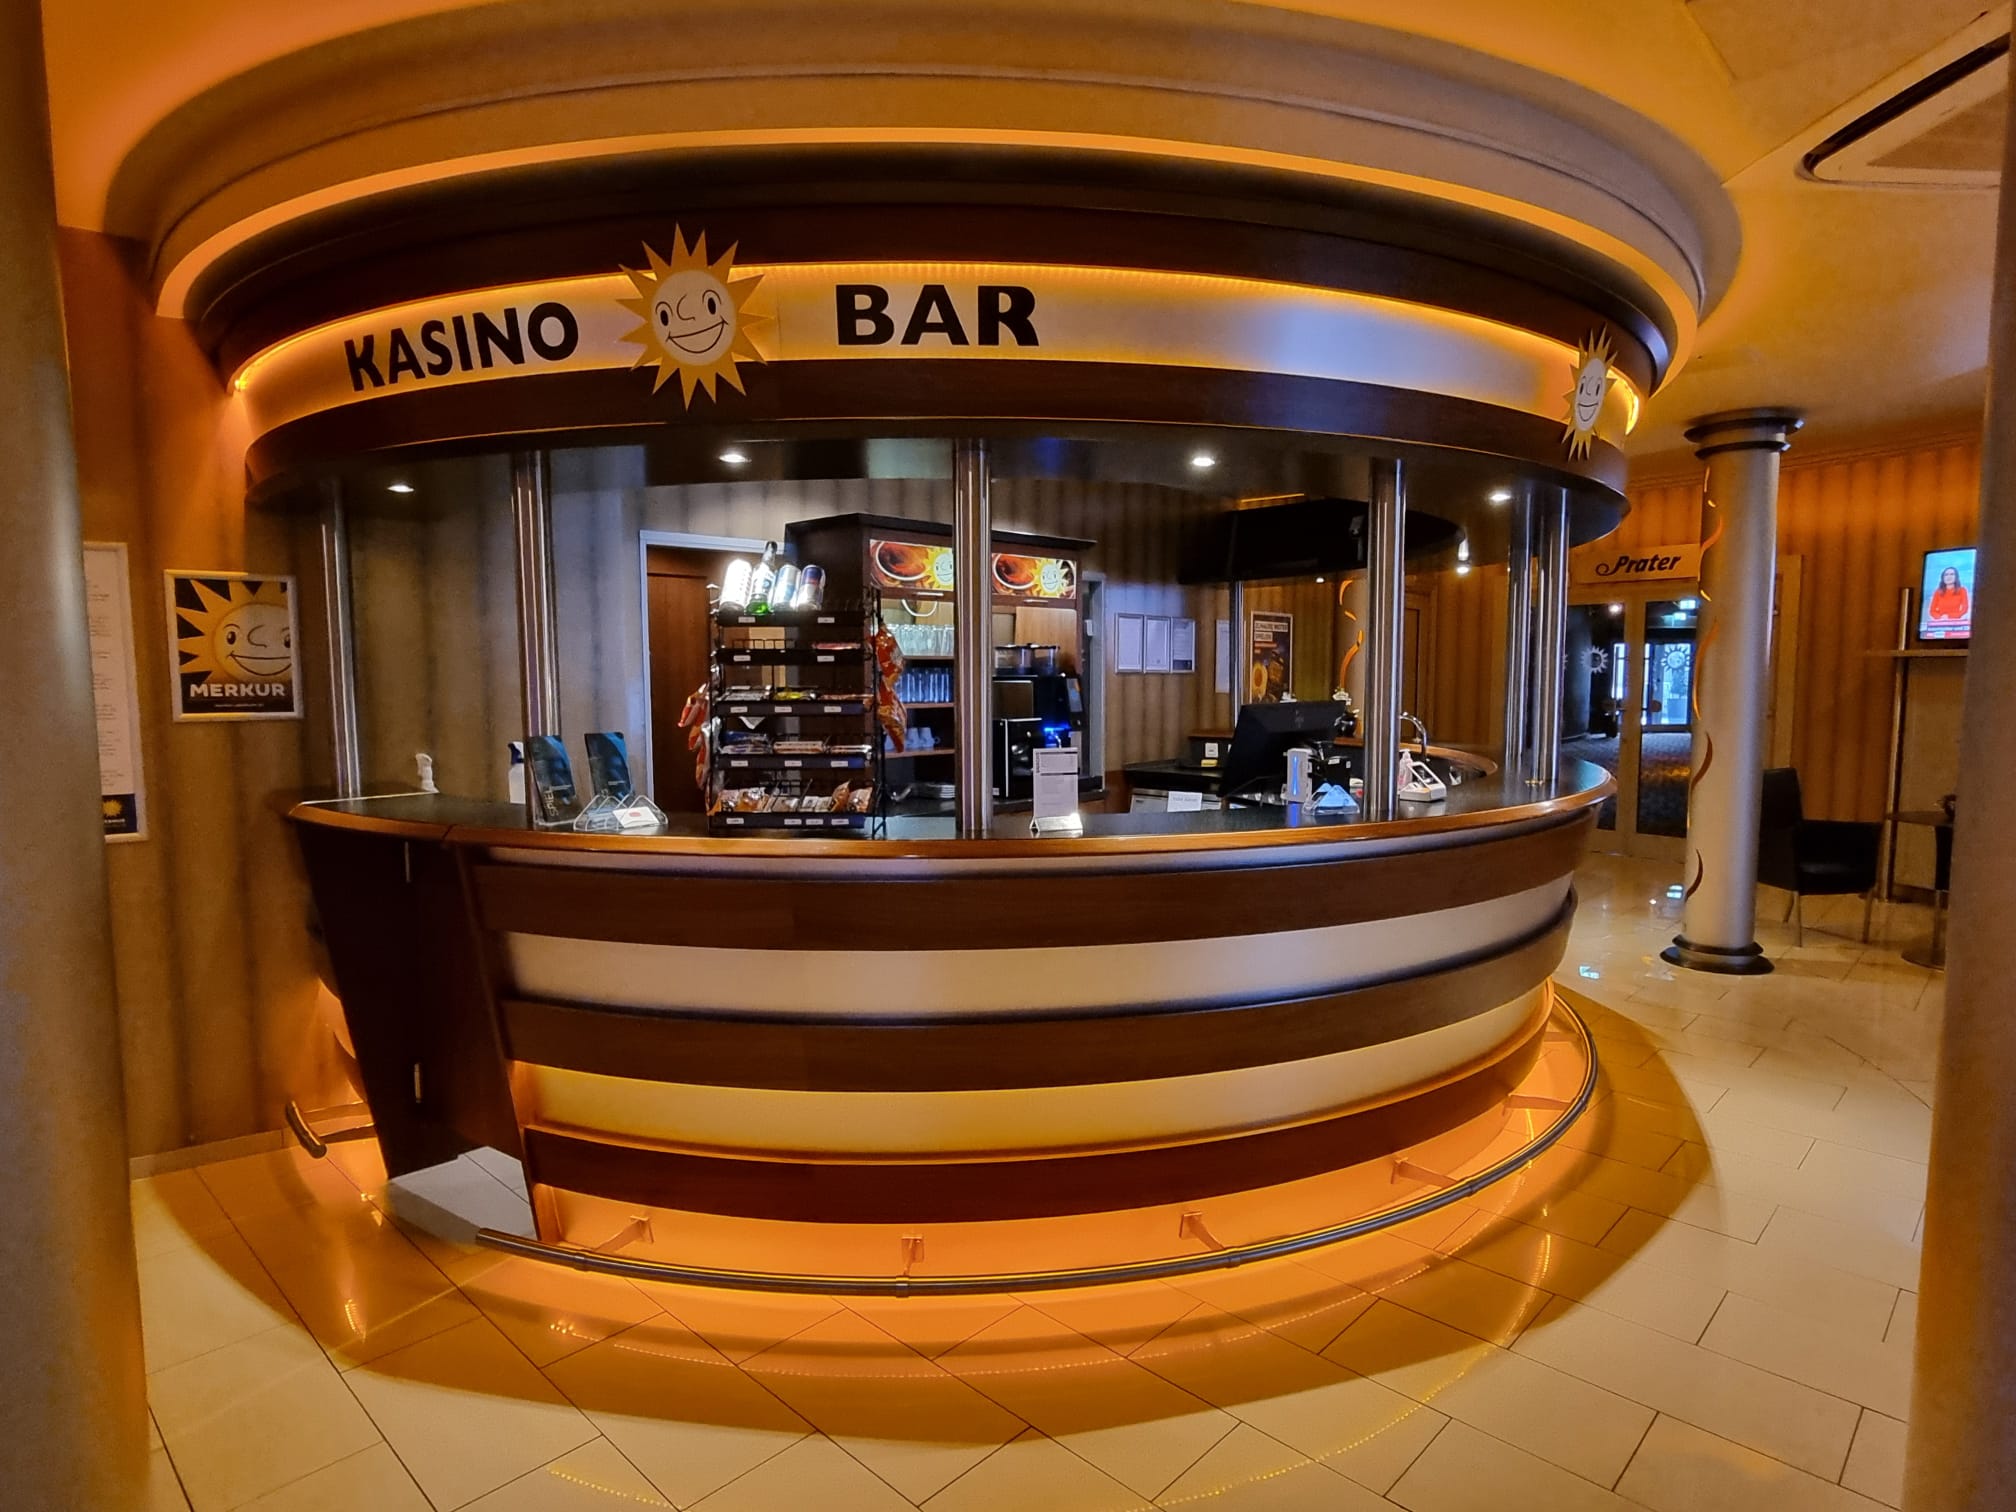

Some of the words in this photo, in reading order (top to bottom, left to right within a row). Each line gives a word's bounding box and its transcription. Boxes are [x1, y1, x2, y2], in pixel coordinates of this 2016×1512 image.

[344, 302, 579, 392] KASINO
[836, 284, 1040, 346] BAR
[1595, 554, 1682, 577] Prater
[189, 683, 286, 698] MERKUR
